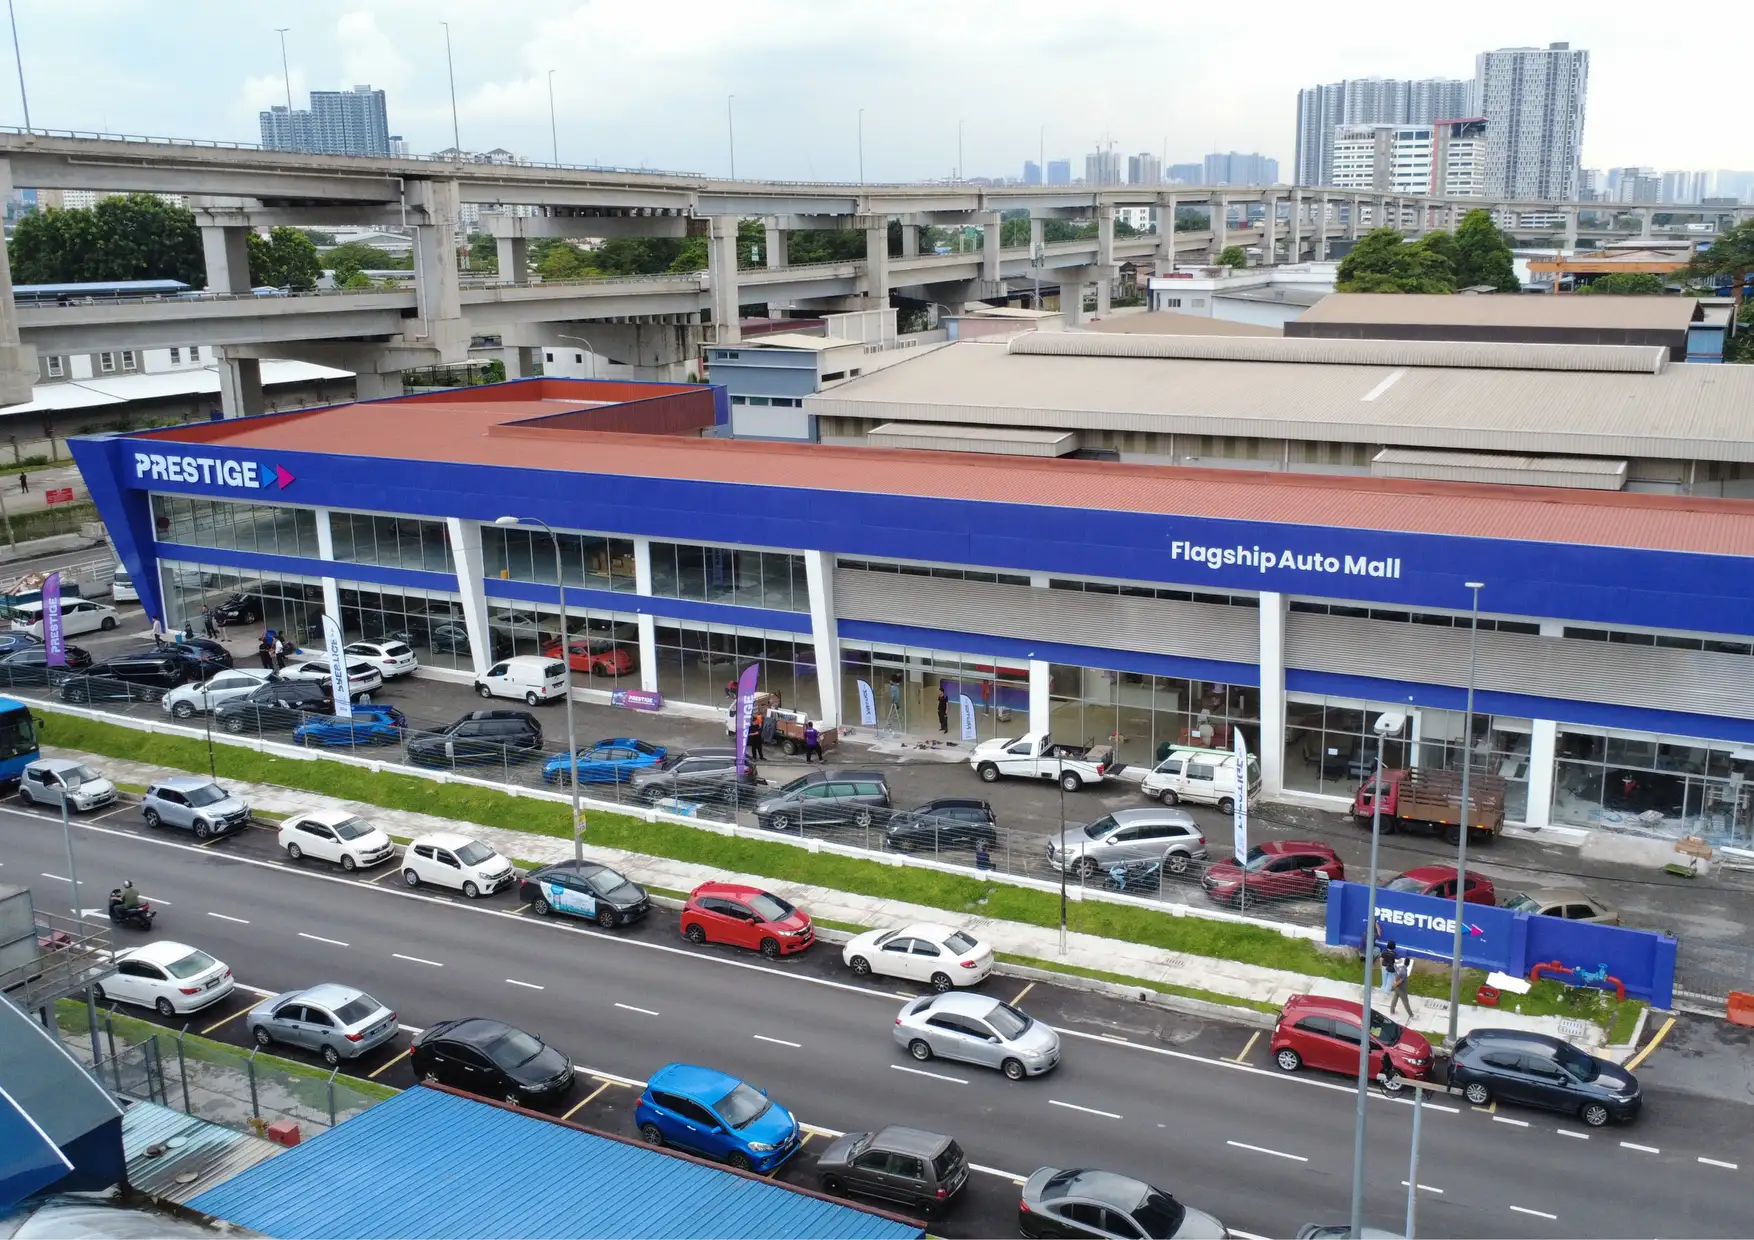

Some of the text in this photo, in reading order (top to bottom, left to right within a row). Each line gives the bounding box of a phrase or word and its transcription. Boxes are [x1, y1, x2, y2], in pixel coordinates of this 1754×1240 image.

[135, 453, 260, 488] PRESTIGE
[1171, 541, 1400, 579] Flagship Auto Mall
[48, 597, 61, 654] PRESTIGE
